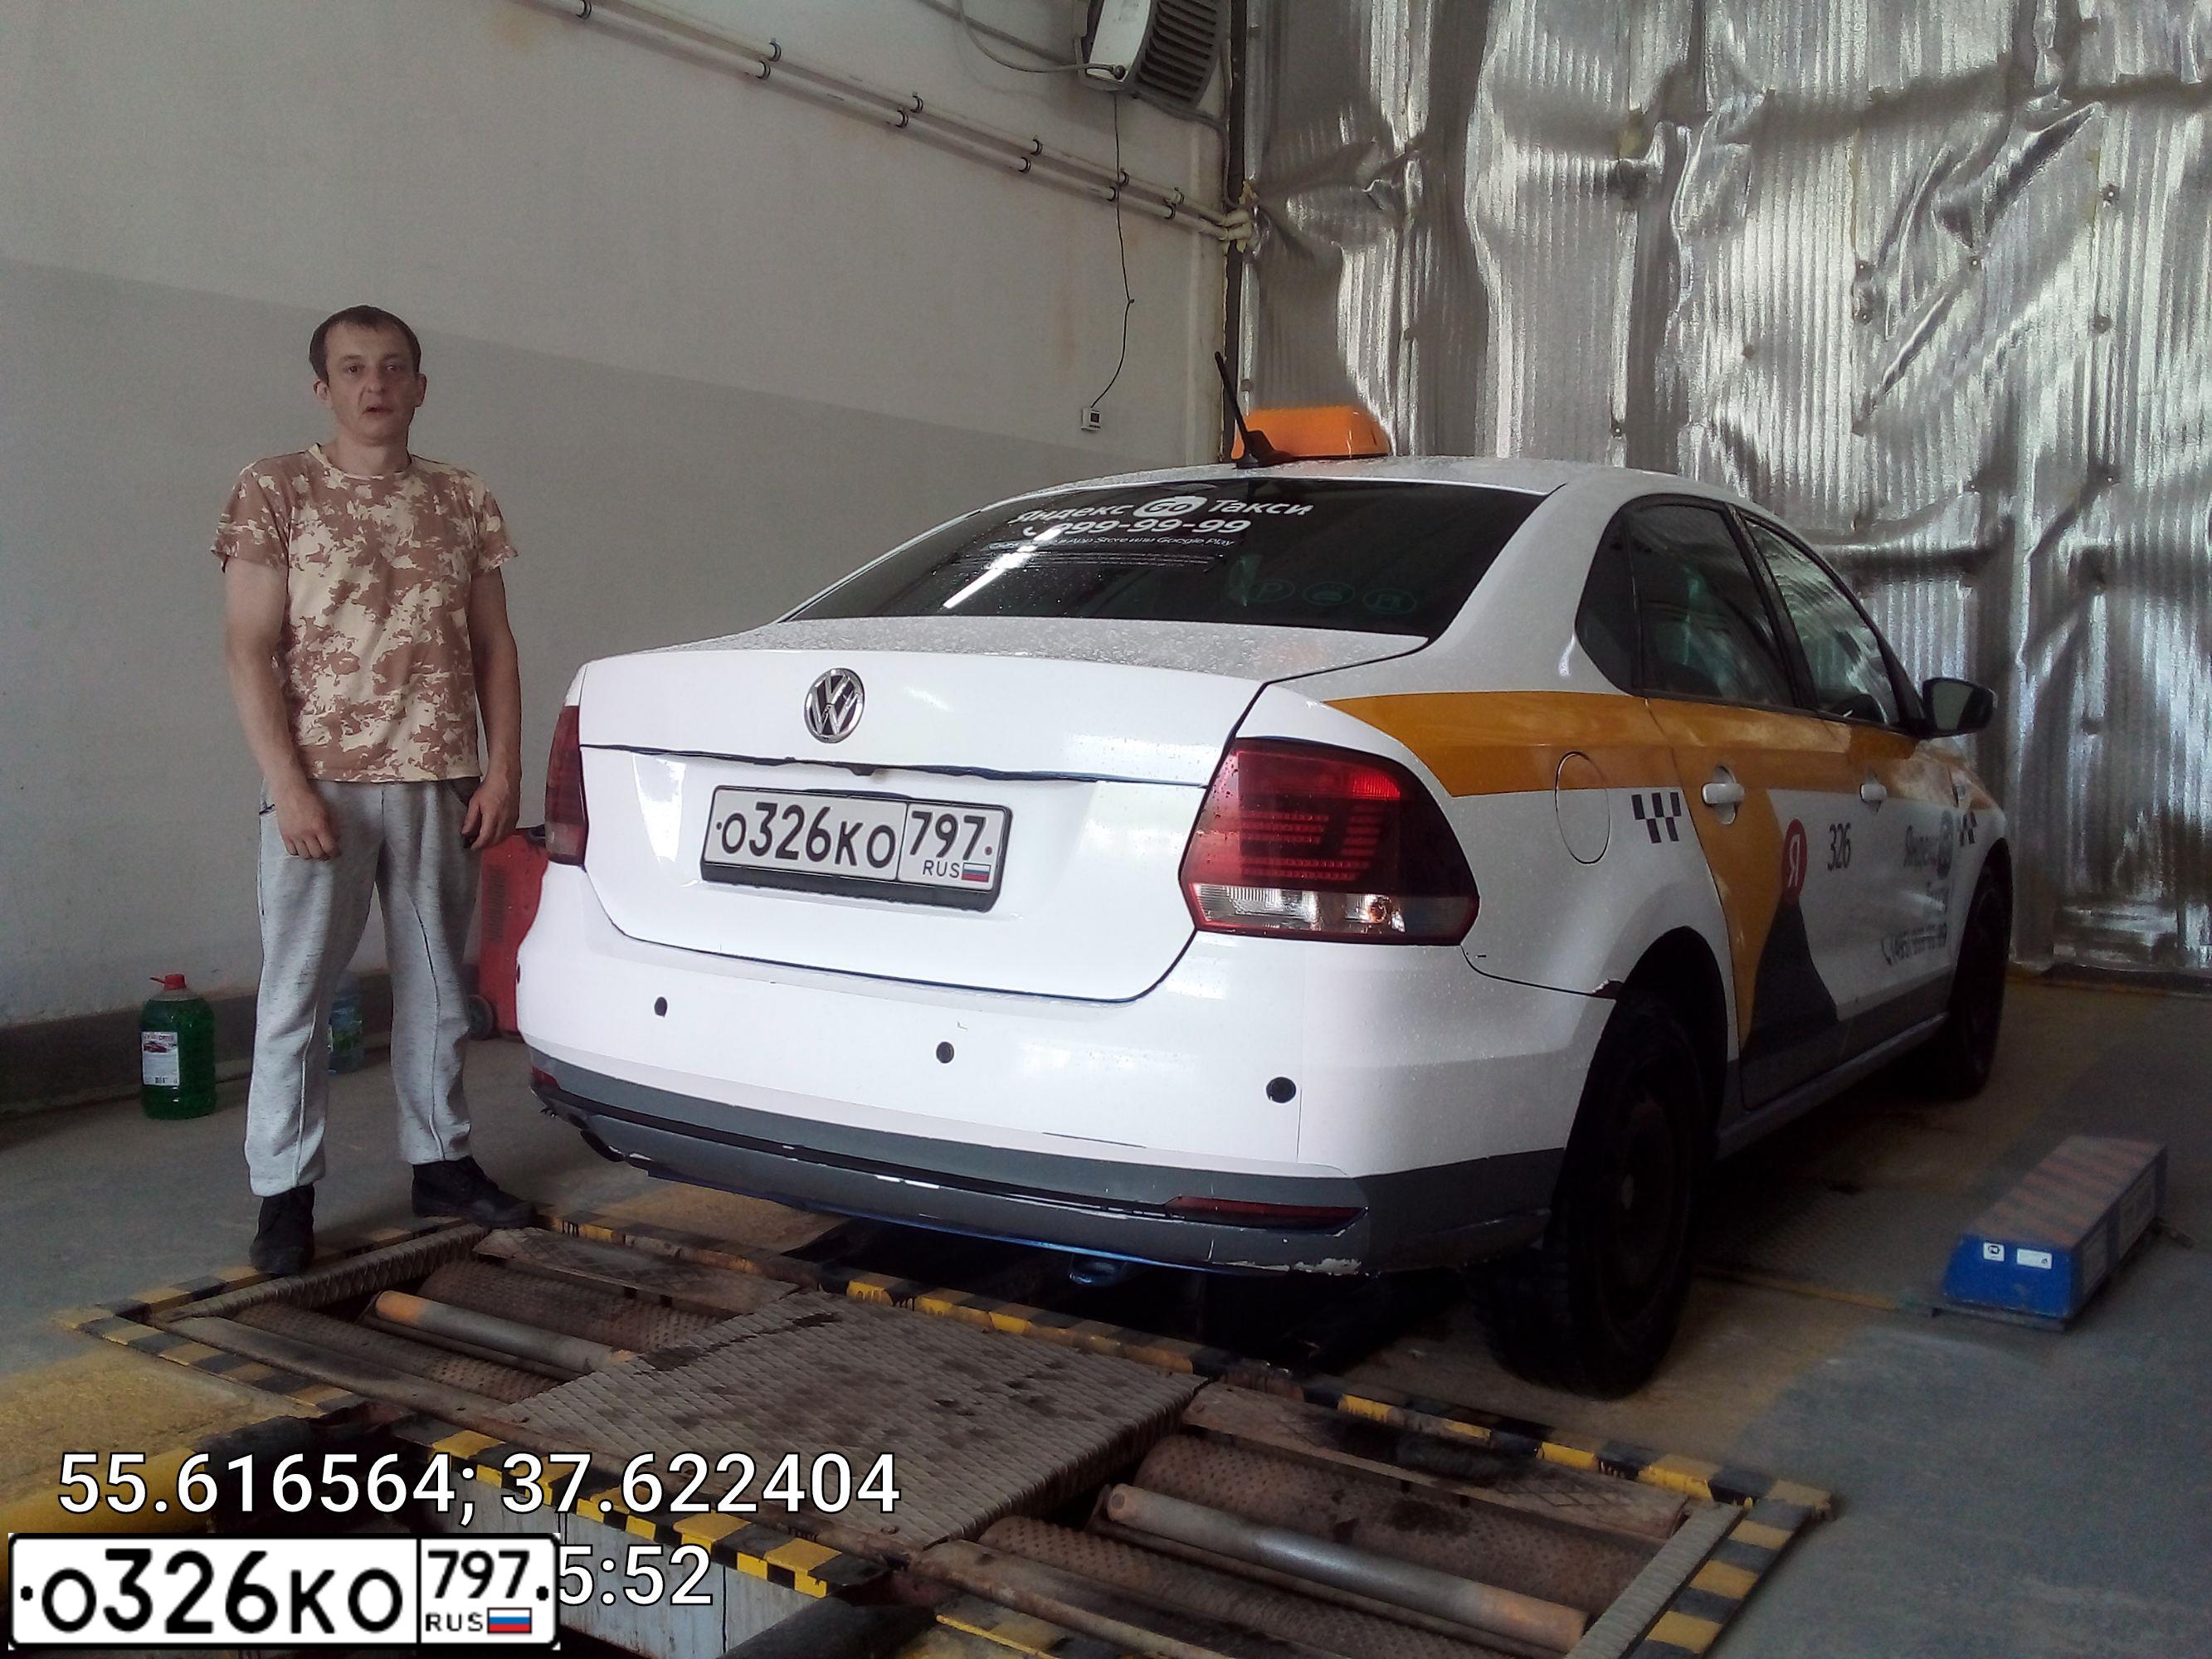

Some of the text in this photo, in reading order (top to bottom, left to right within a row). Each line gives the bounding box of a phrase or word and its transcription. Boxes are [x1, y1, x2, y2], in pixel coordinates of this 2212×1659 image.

[1007, 504, 1134, 524] Яндекс
[1208, 499, 1314, 515] Такси
[1157, 537, 1205, 545] Google
[1206, 538, 1235, 547] Play
[909, 810, 987, 862] 797
[922, 859, 961, 879] RUS
